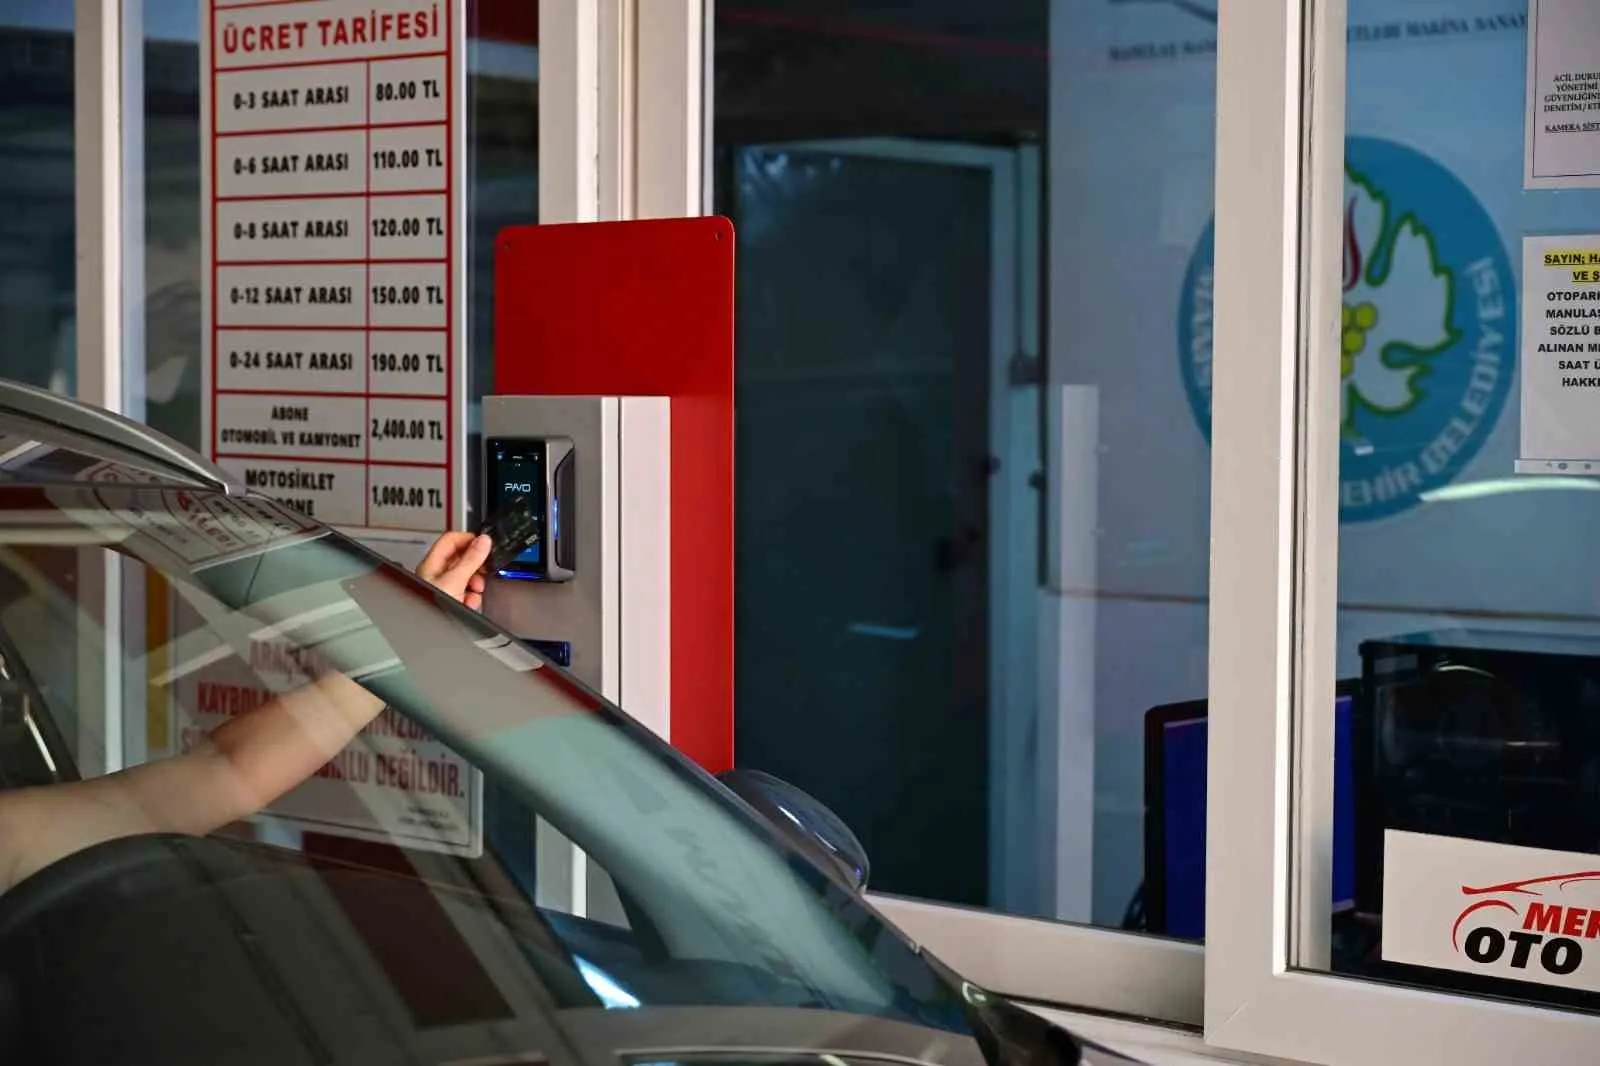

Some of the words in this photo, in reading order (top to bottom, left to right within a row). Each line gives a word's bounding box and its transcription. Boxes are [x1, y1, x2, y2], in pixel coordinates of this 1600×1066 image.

[223, 22, 307, 54] ÜCRET
[317, 4, 439, 46] TARİFESİ
[234, 92, 255, 110] 0-3
[261, 90, 299, 109] SAAT
[305, 86, 349, 105] ARASI
[376, 82, 416, 102] 80.00
[422, 80, 440, 99] TL
[234, 157, 256, 175] 0-6
[261, 155, 299, 174] SAAT
[305, 153, 349, 171] ARASI
[373, 150, 419, 169] 110.00
[425, 149, 443, 167] TL
[234, 222, 256, 240] 0-8
[261, 221, 299, 240] SAAT
[305, 220, 349, 238] ARASI
[372, 219, 420, 237] 120.00
[426, 218, 443, 236] TL
[1544, 254, 1585, 265] SAYIN;
[1572, 271, 1588, 281] VE
[230, 287, 259, 304] 0-12
[265, 287, 302, 304] SAAT
[308, 287, 352, 304] ARASI
[372, 286, 420, 305] 150.00
[426, 286, 444, 304] TL
[1550, 324, 1590, 335] SÖZLÜ
[1538, 343, 1583, 352] ALINAN
[1588, 343, 1600, 352] M
[229, 352, 260, 369] 0-24
[266, 352, 303, 370] SAAT
[309, 353, 352, 370] ARASI
[372, 354, 420, 372] 190.00
[426, 355, 444, 372] TL
[1558, 360, 1590, 370] SAAT
[271, 406, 309, 421] ABONE
[221, 428, 277, 445] OTOMOBİL
[281, 431, 295, 445] VE
[299, 432, 361, 448] KAMYONET
[372, 418, 424, 440] 2,400.00
[428, 421, 443, 441] TL
[245, 468, 335, 491] MOTOSİKLET
[372, 486, 424, 508] 1,000.00
[427, 489, 443, 509] TL
[376, 748, 465, 798] DEĞİLDİR.
[1464, 926, 1583, 975] OTO
